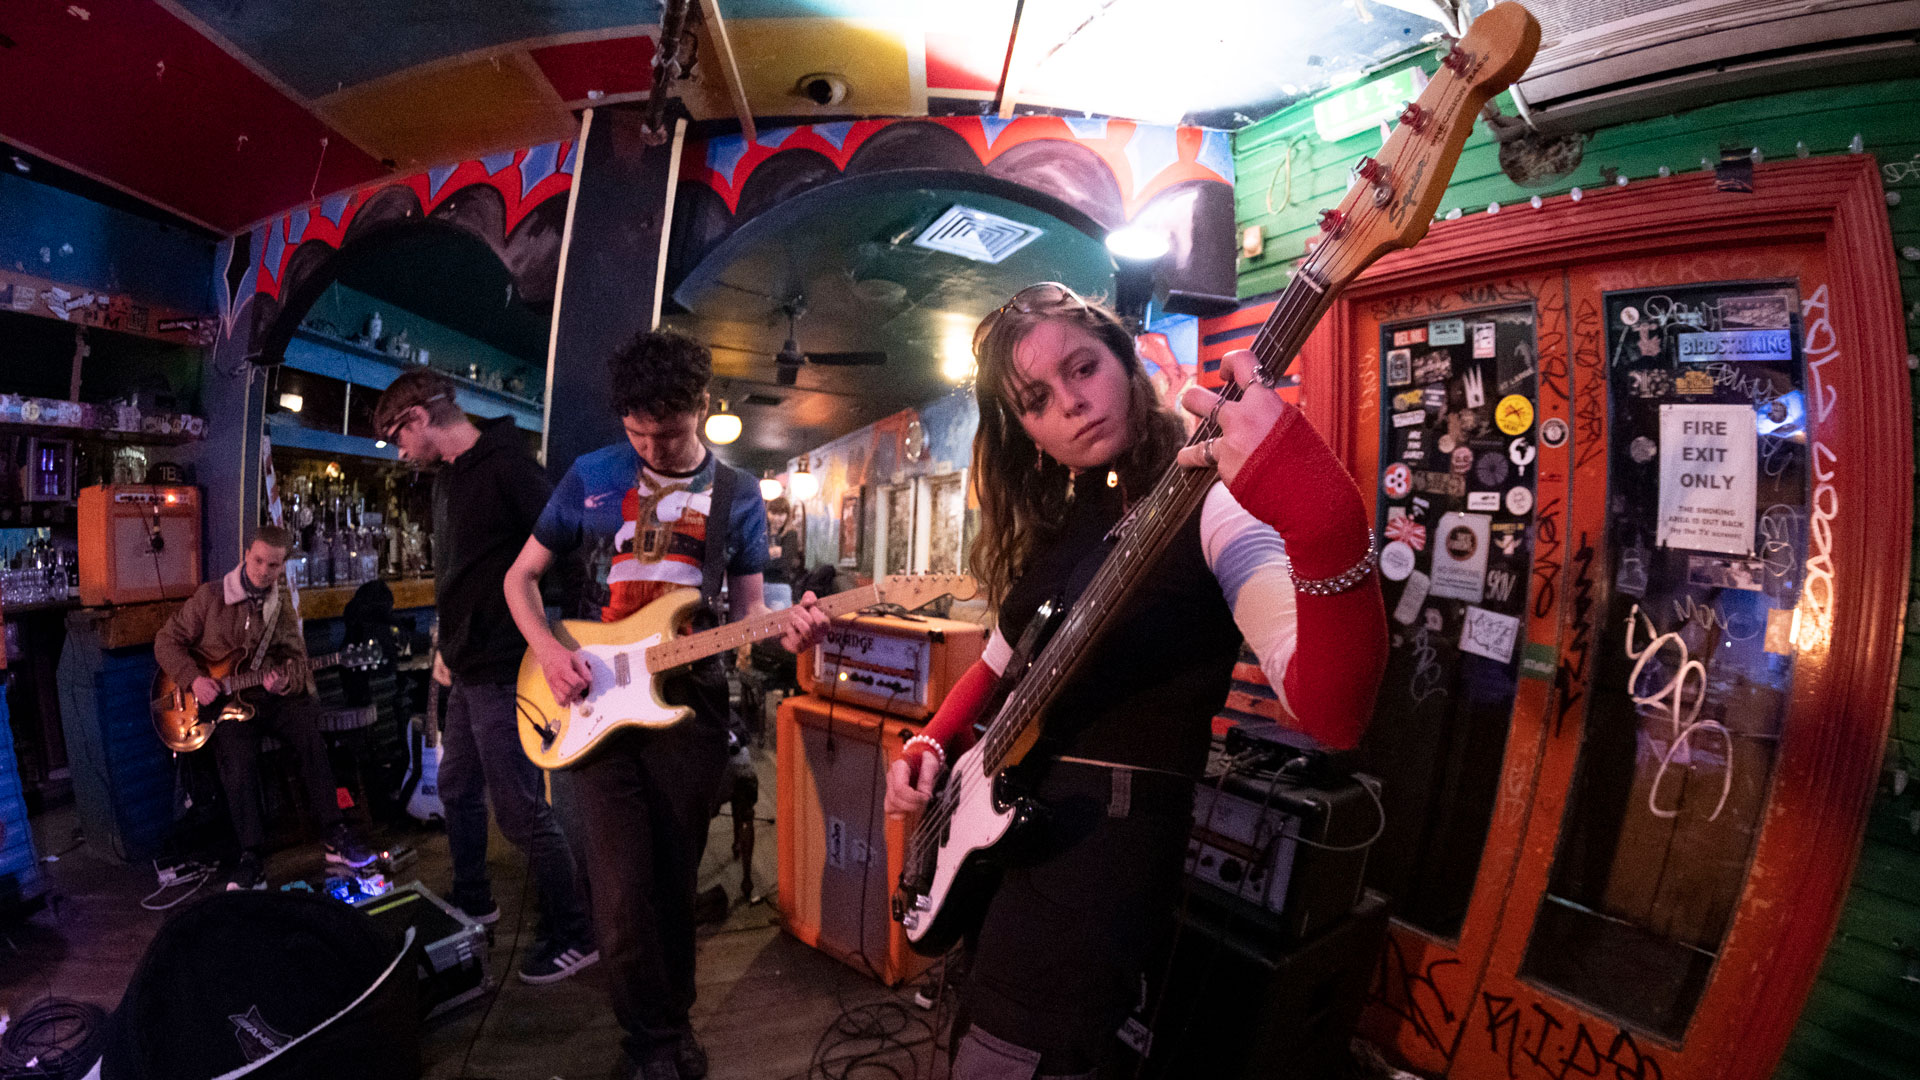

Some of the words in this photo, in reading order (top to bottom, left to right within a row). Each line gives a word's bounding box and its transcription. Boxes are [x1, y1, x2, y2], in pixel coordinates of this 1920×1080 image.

[1465, 51, 1490, 84] BASS
[1682, 336, 1790, 356] BIRDSTRIKING
[1682, 420, 1727, 436] FIRE
[1682, 446, 1728, 463] EXIT
[1680, 472, 1734, 490] ONLY
[1678, 505, 1693, 513] THE
[1696, 507, 1736, 516] SMOKING
[1721, 520, 1745, 528] BACK
[827, 630, 874, 654] ORANGE
